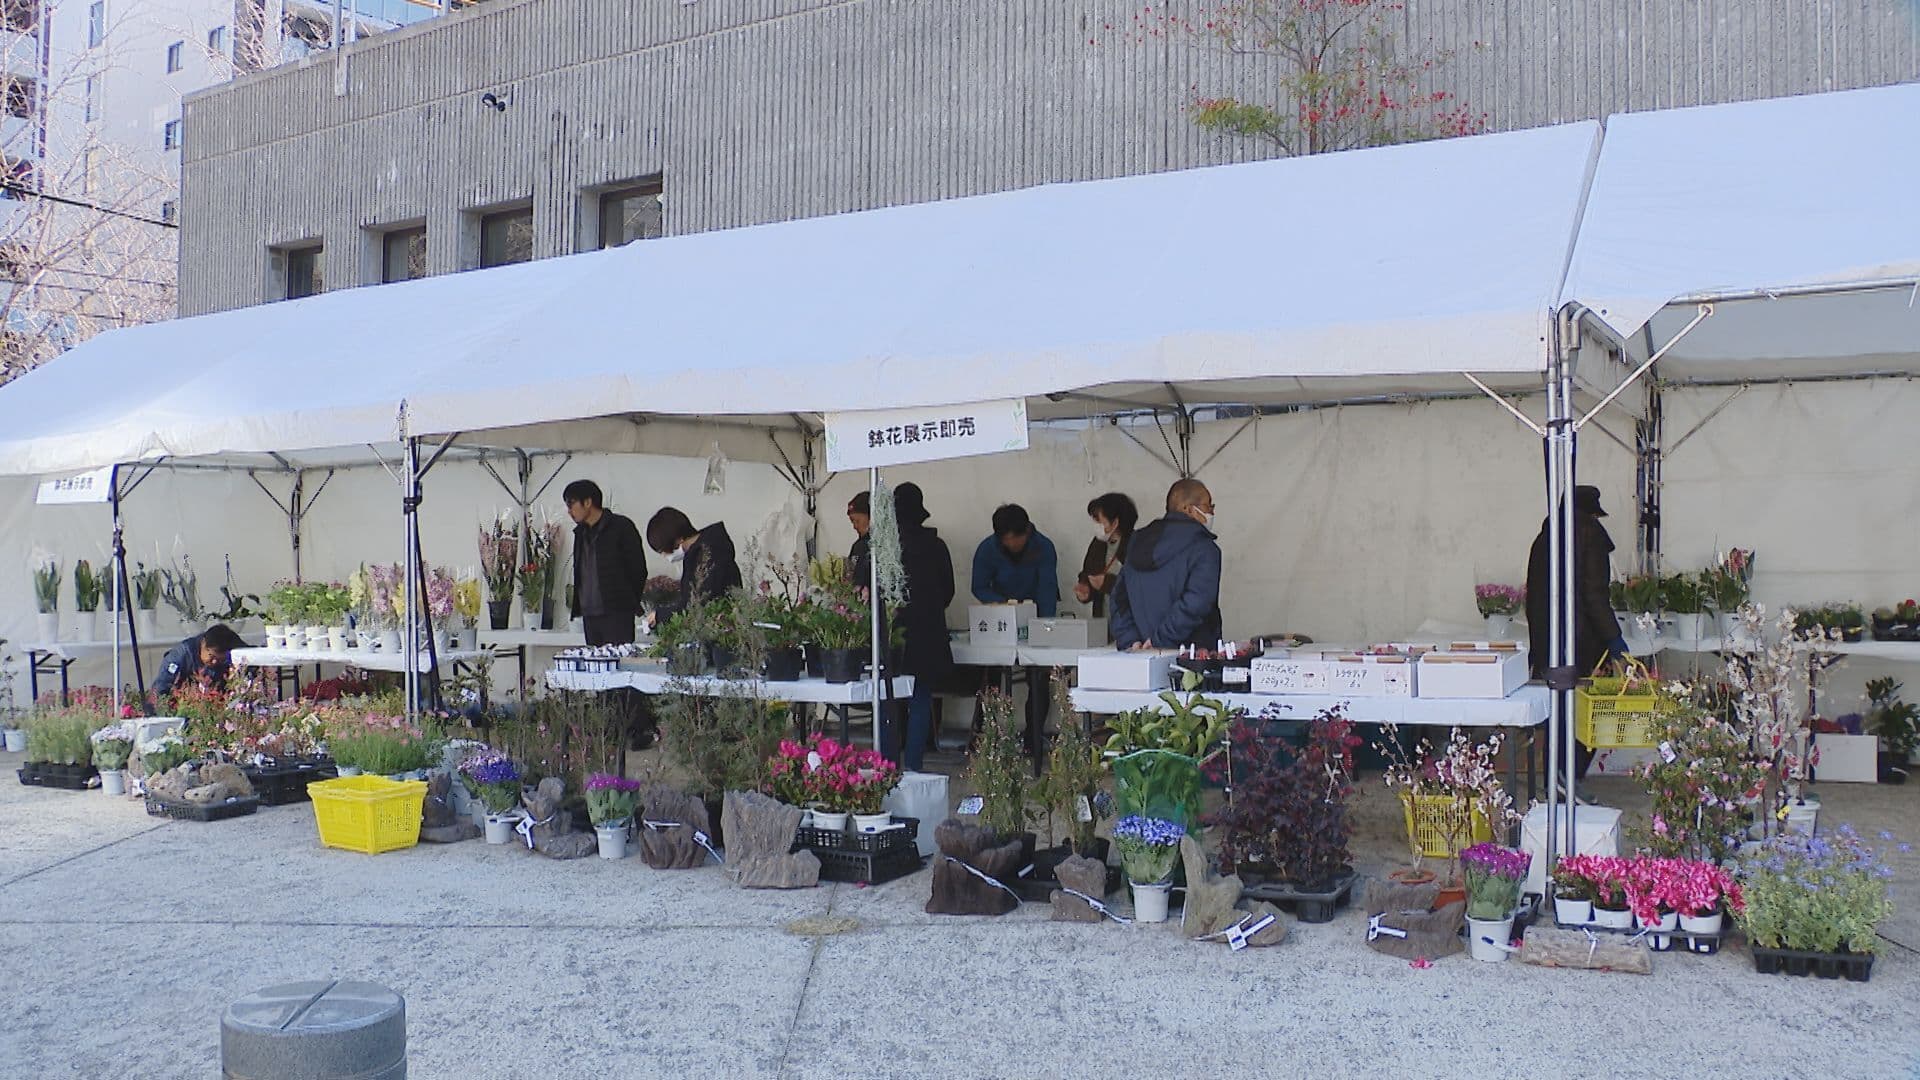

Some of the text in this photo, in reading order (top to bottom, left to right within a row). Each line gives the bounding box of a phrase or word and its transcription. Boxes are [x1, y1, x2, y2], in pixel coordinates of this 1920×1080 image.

[868, 417, 976, 448] 鉢花展示即売
